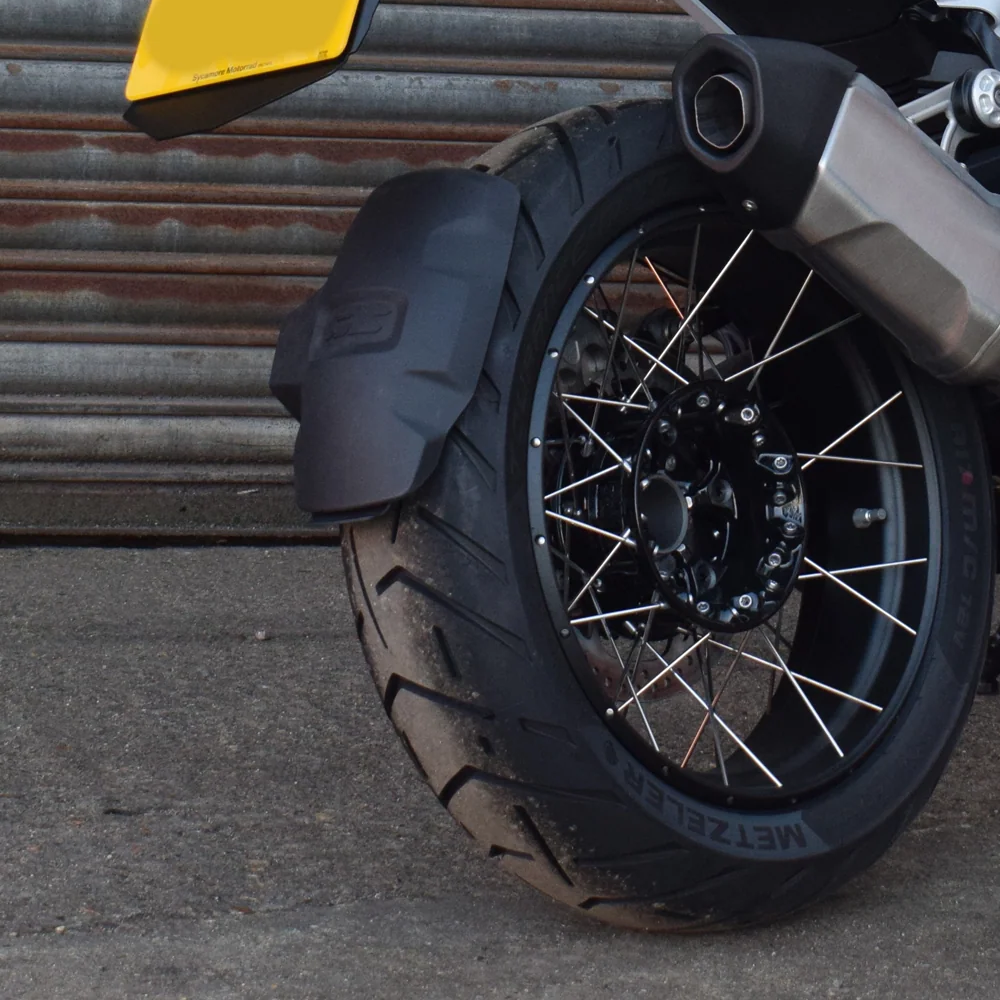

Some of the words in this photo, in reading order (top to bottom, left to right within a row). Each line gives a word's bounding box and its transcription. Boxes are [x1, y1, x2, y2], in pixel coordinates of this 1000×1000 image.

[192, 69, 226, 84] Sycamore
[226, 61, 258, 74] Motorrad
[623, 762, 807, 851] METZELER
